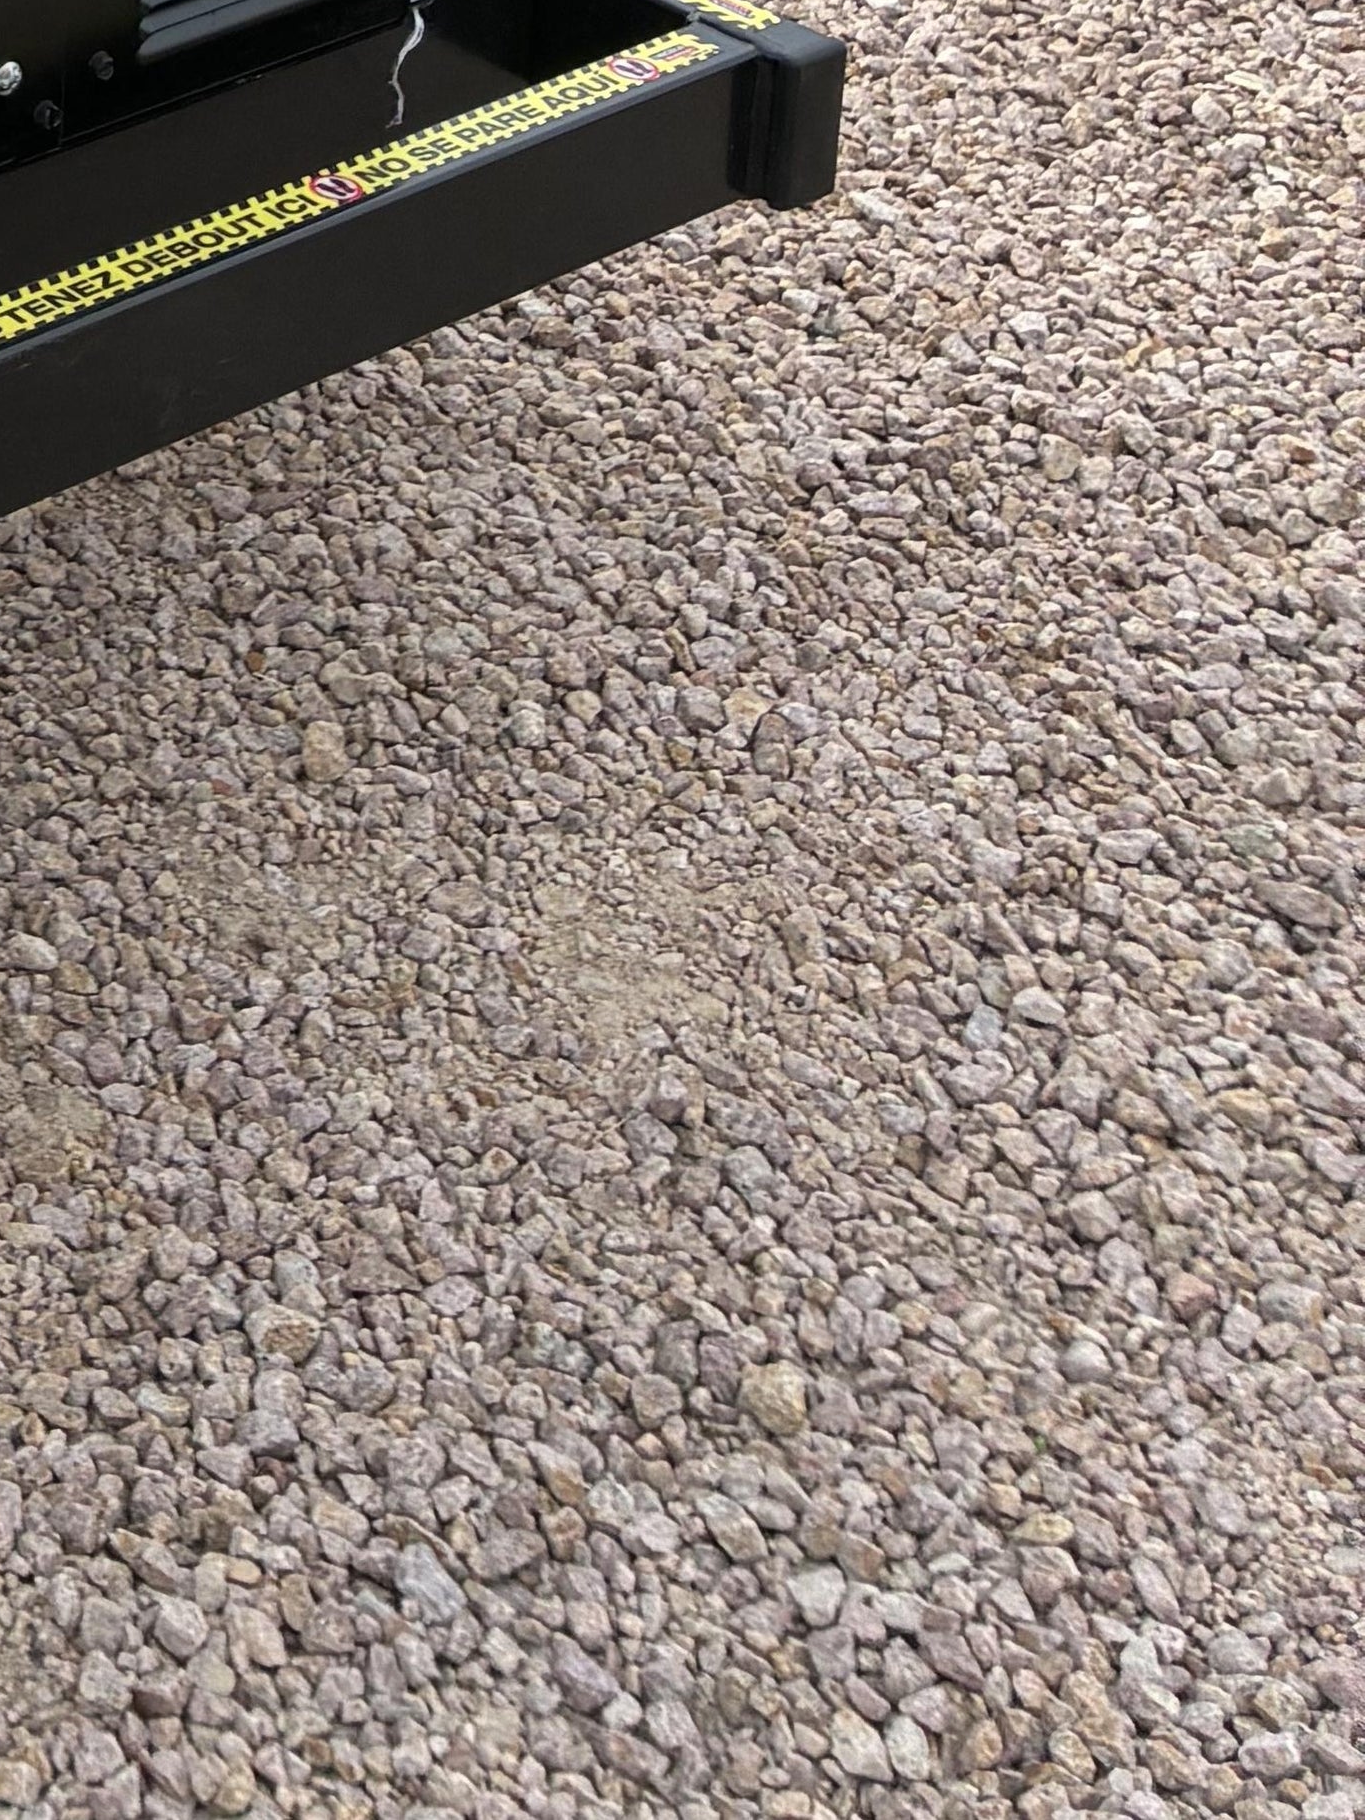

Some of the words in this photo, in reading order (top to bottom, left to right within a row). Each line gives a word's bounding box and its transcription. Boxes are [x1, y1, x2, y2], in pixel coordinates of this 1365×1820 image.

[355, 156, 413, 186] NO
[417, 139, 458, 163] SE
[461, 102, 544, 146] PARE
[4, 273, 120, 326] TENEZ
[118, 212, 265, 280] DEBOUT
[270, 191, 316, 221] ICI
